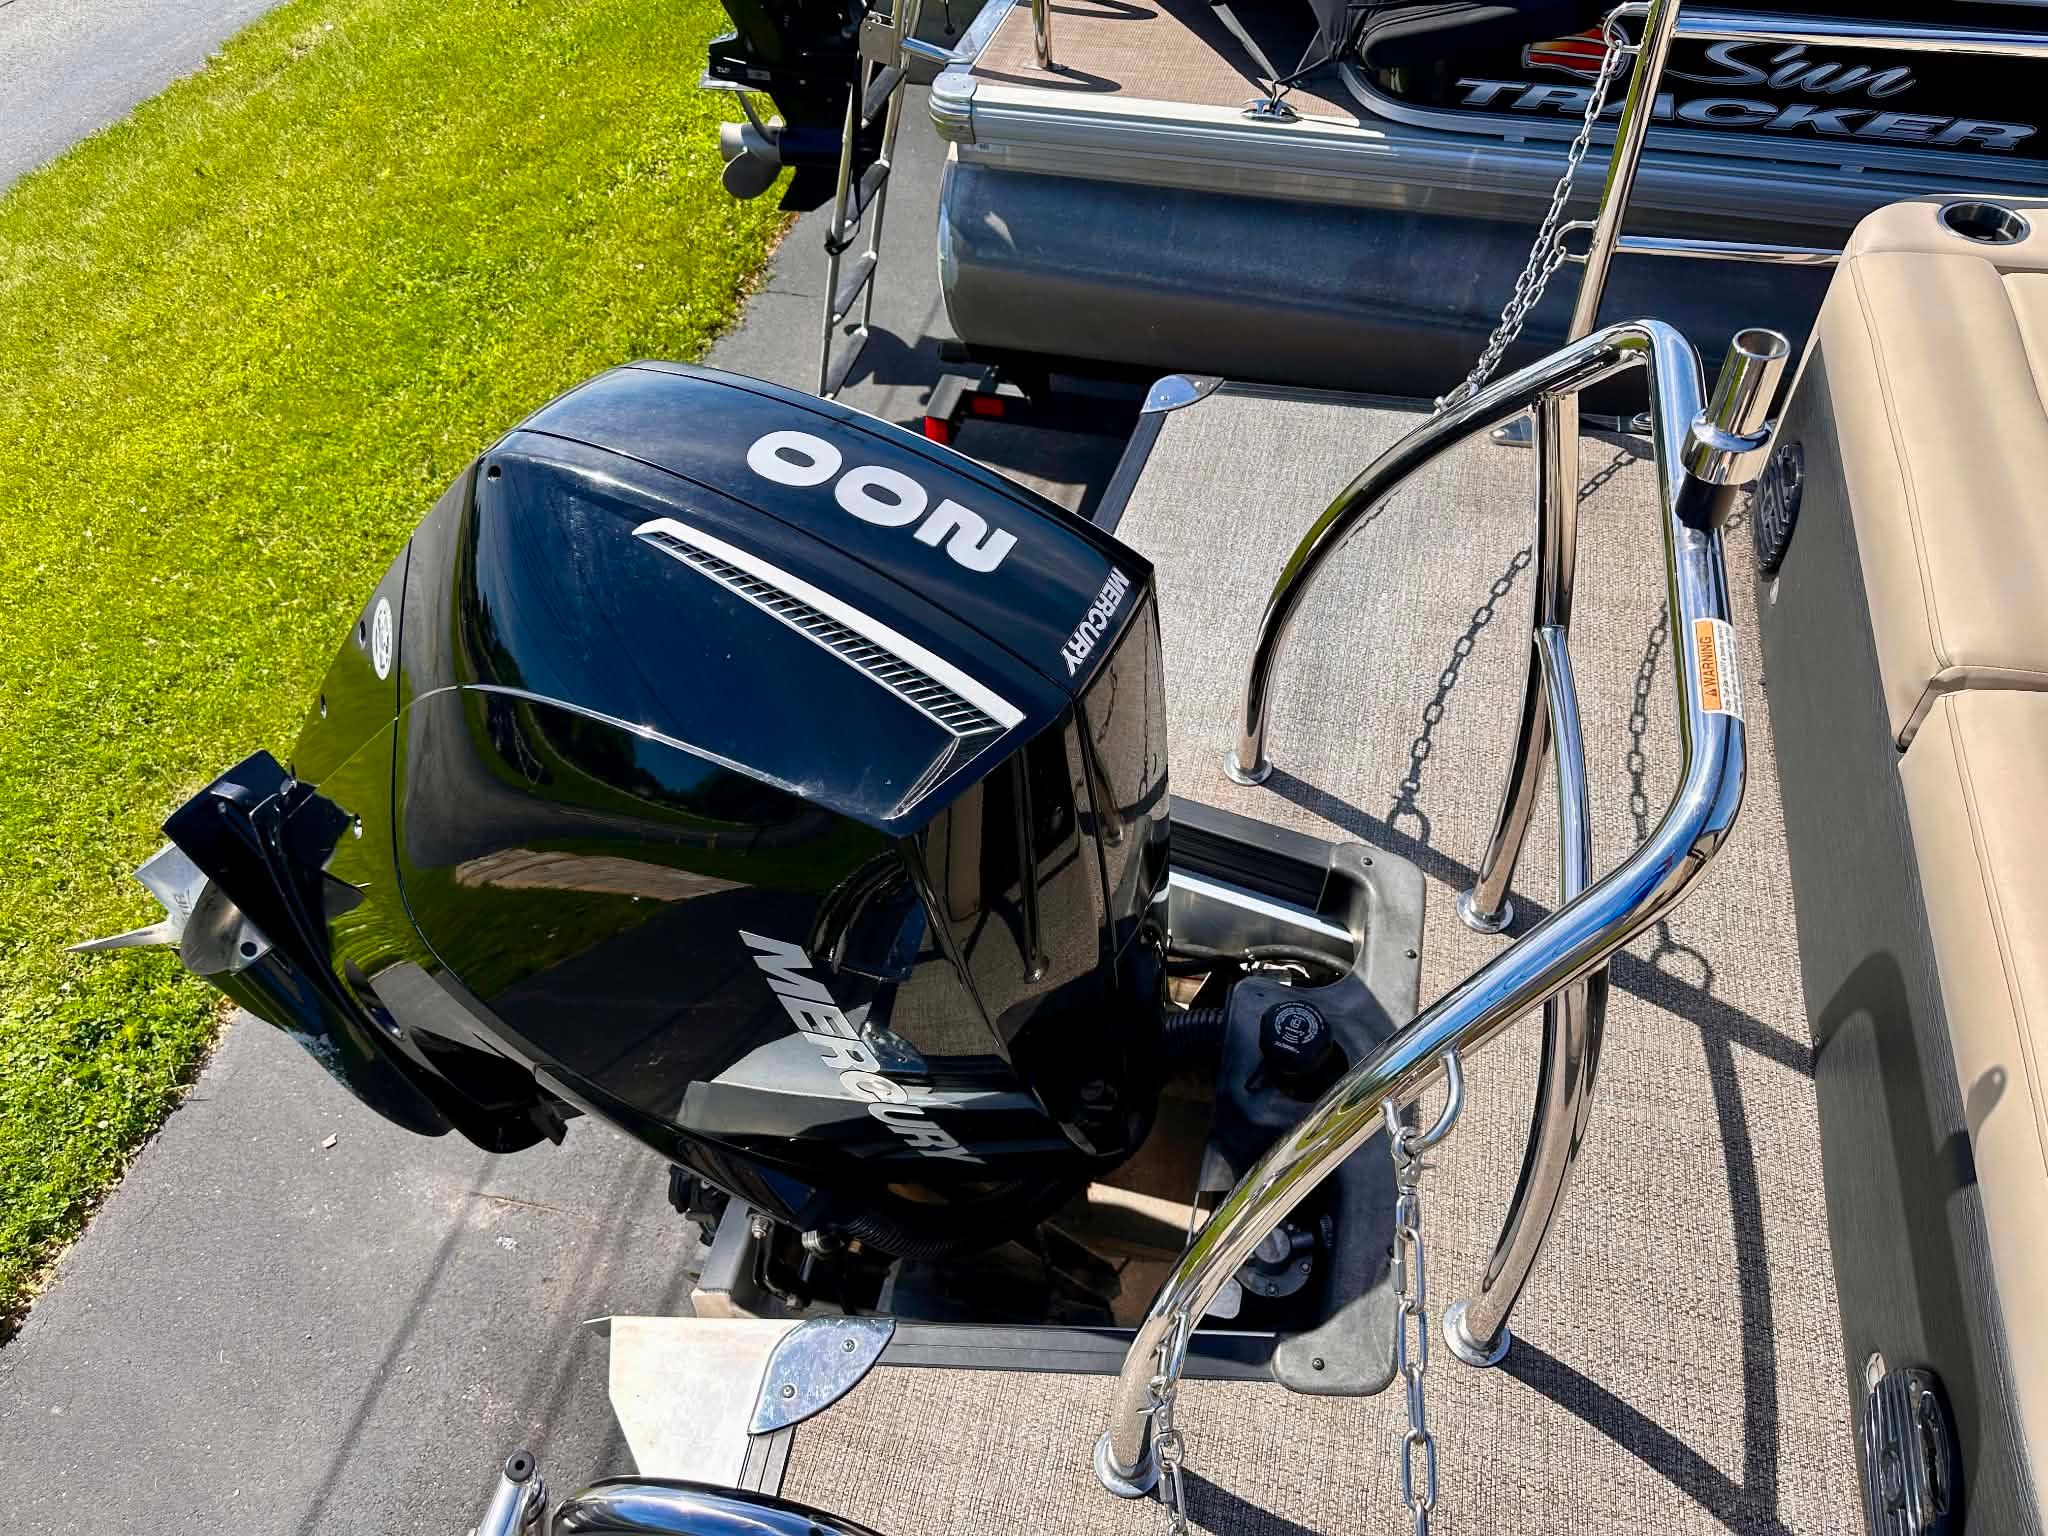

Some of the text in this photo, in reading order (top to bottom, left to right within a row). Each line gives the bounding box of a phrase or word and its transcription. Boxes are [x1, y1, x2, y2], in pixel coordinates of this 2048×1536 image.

[1456, 77, 2039, 150] TRACKER
[1664, 42, 1917, 97] Sun
[746, 430, 1019, 573] 200
[1061, 566, 1130, 677] MERCURY
[1699, 635, 1717, 690] WARNING
[738, 930, 987, 1165] MERCURY
